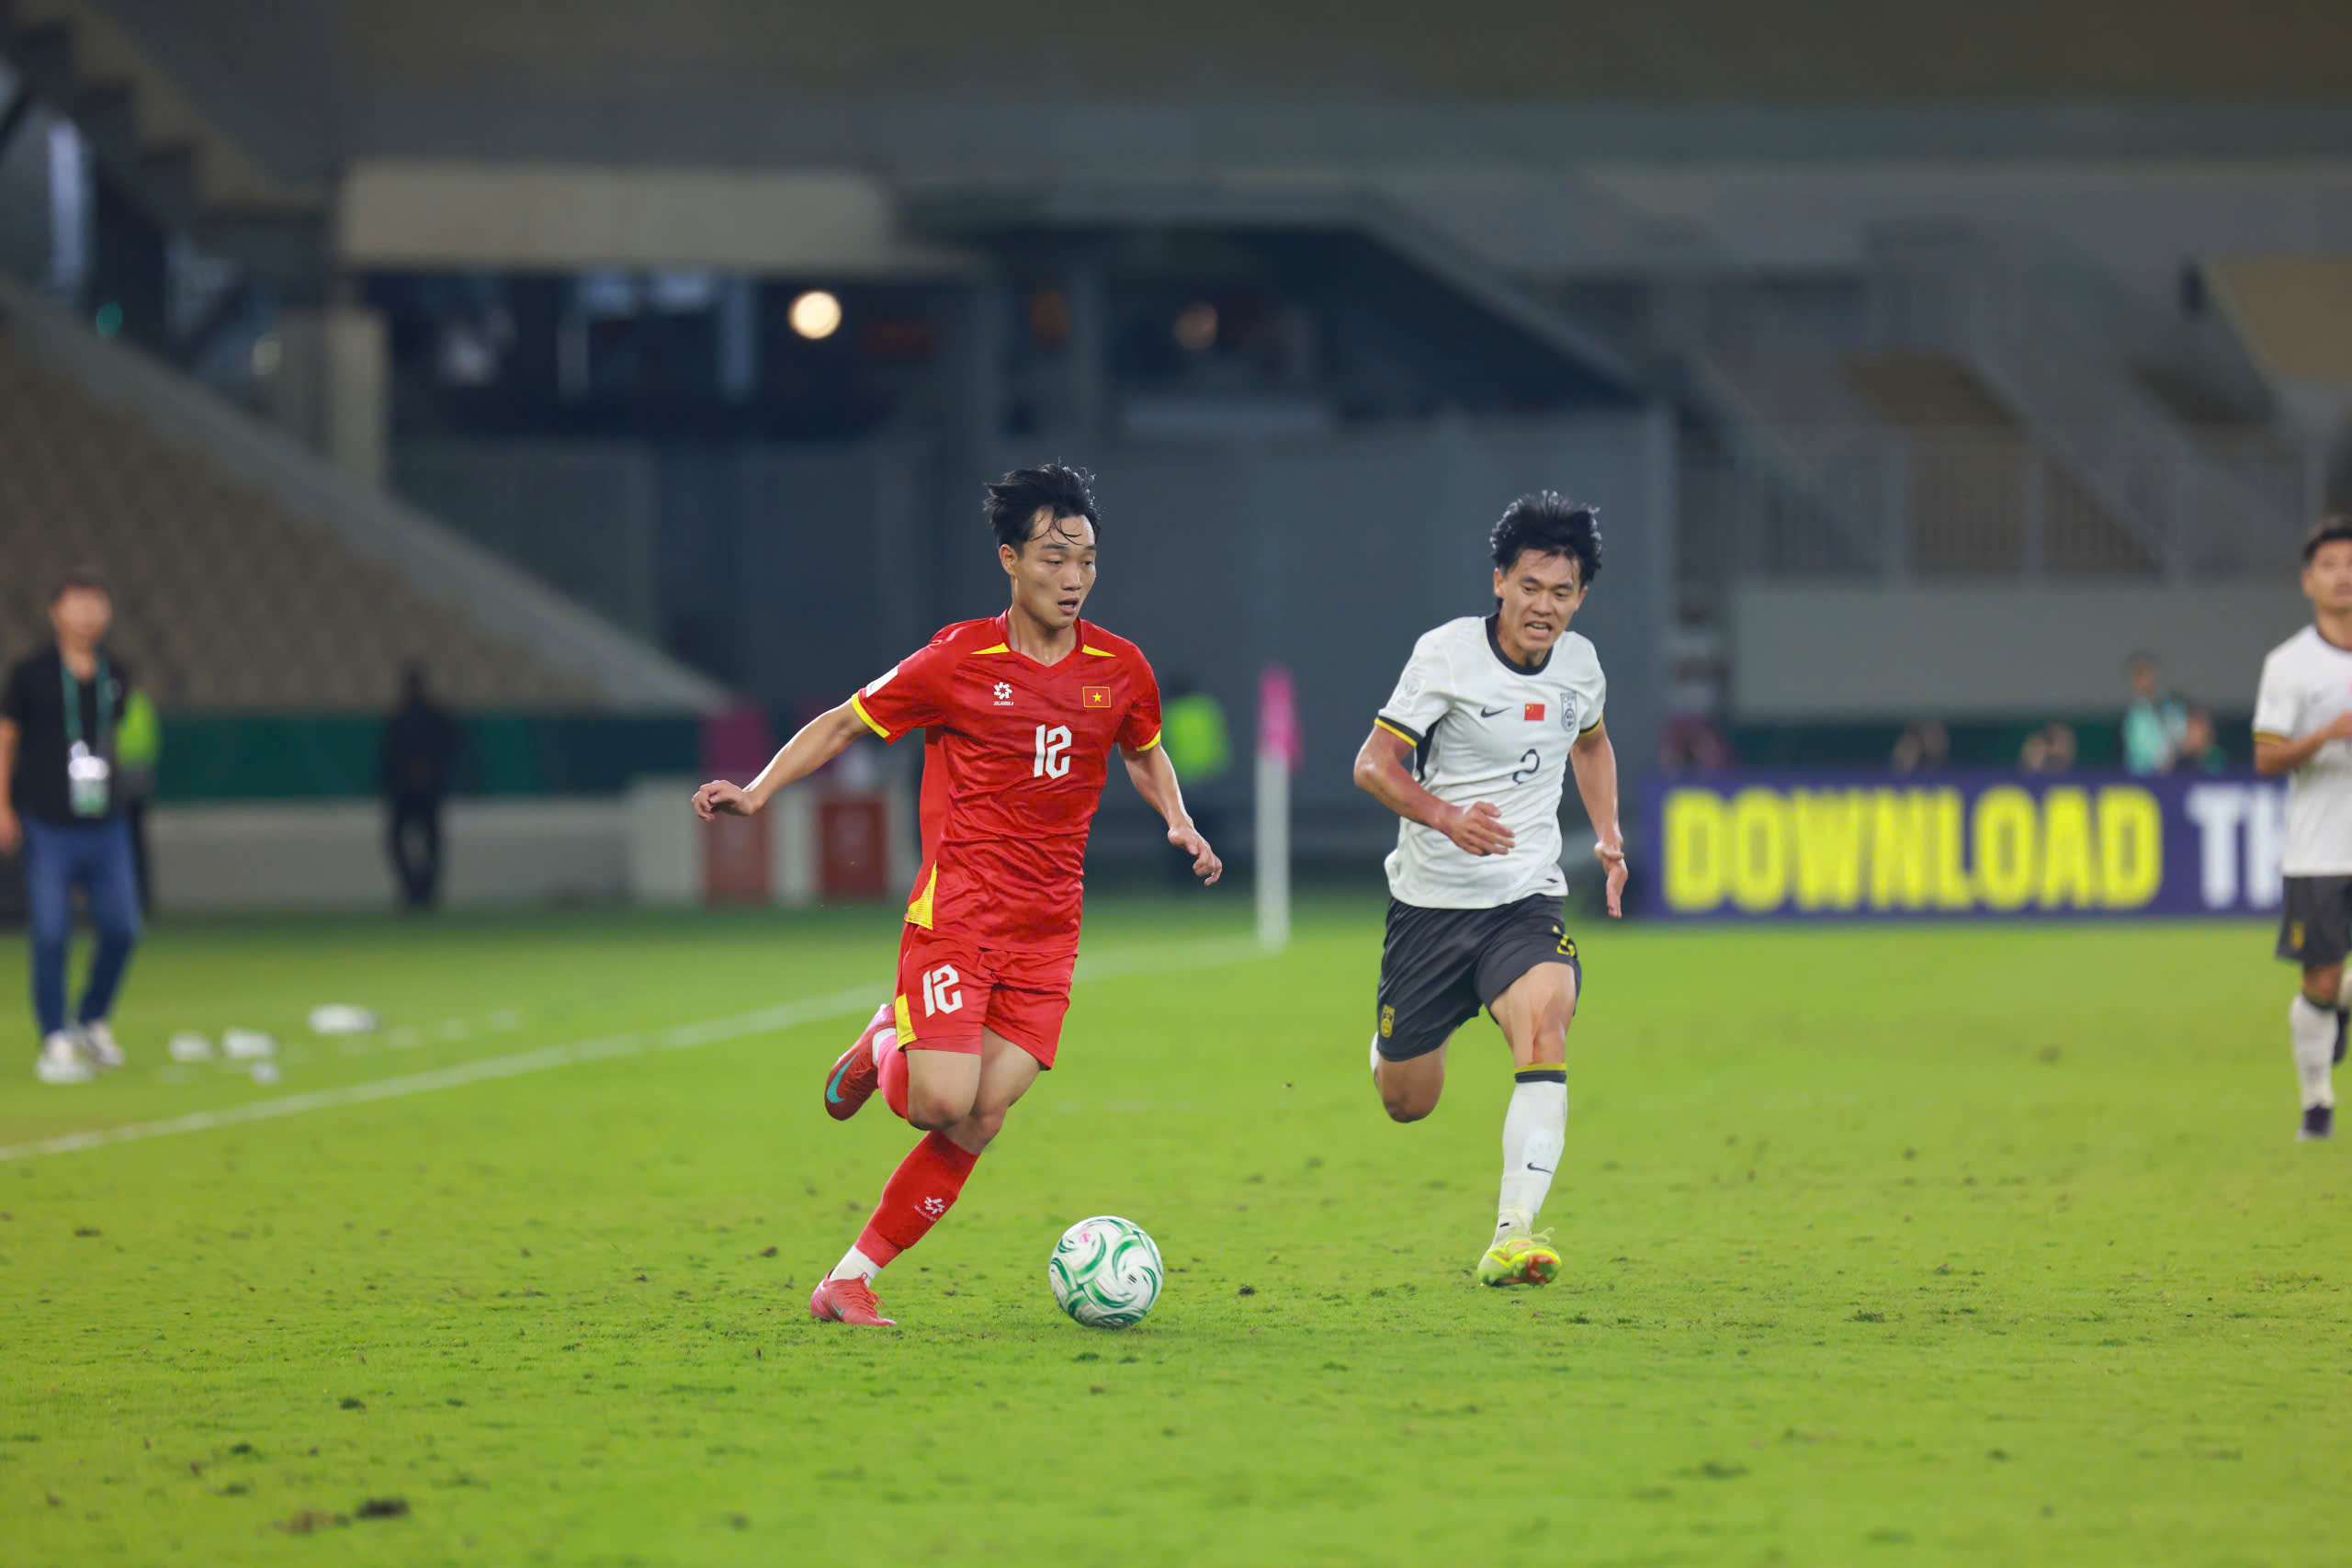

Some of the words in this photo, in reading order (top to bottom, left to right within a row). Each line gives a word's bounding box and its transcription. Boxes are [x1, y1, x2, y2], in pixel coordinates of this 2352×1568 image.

[1034, 724, 1072, 779] 12
[1512, 749, 1540, 785] 2
[1665, 787, 2161, 908] DOWNLOAD
[922, 964, 963, 1018] 12
